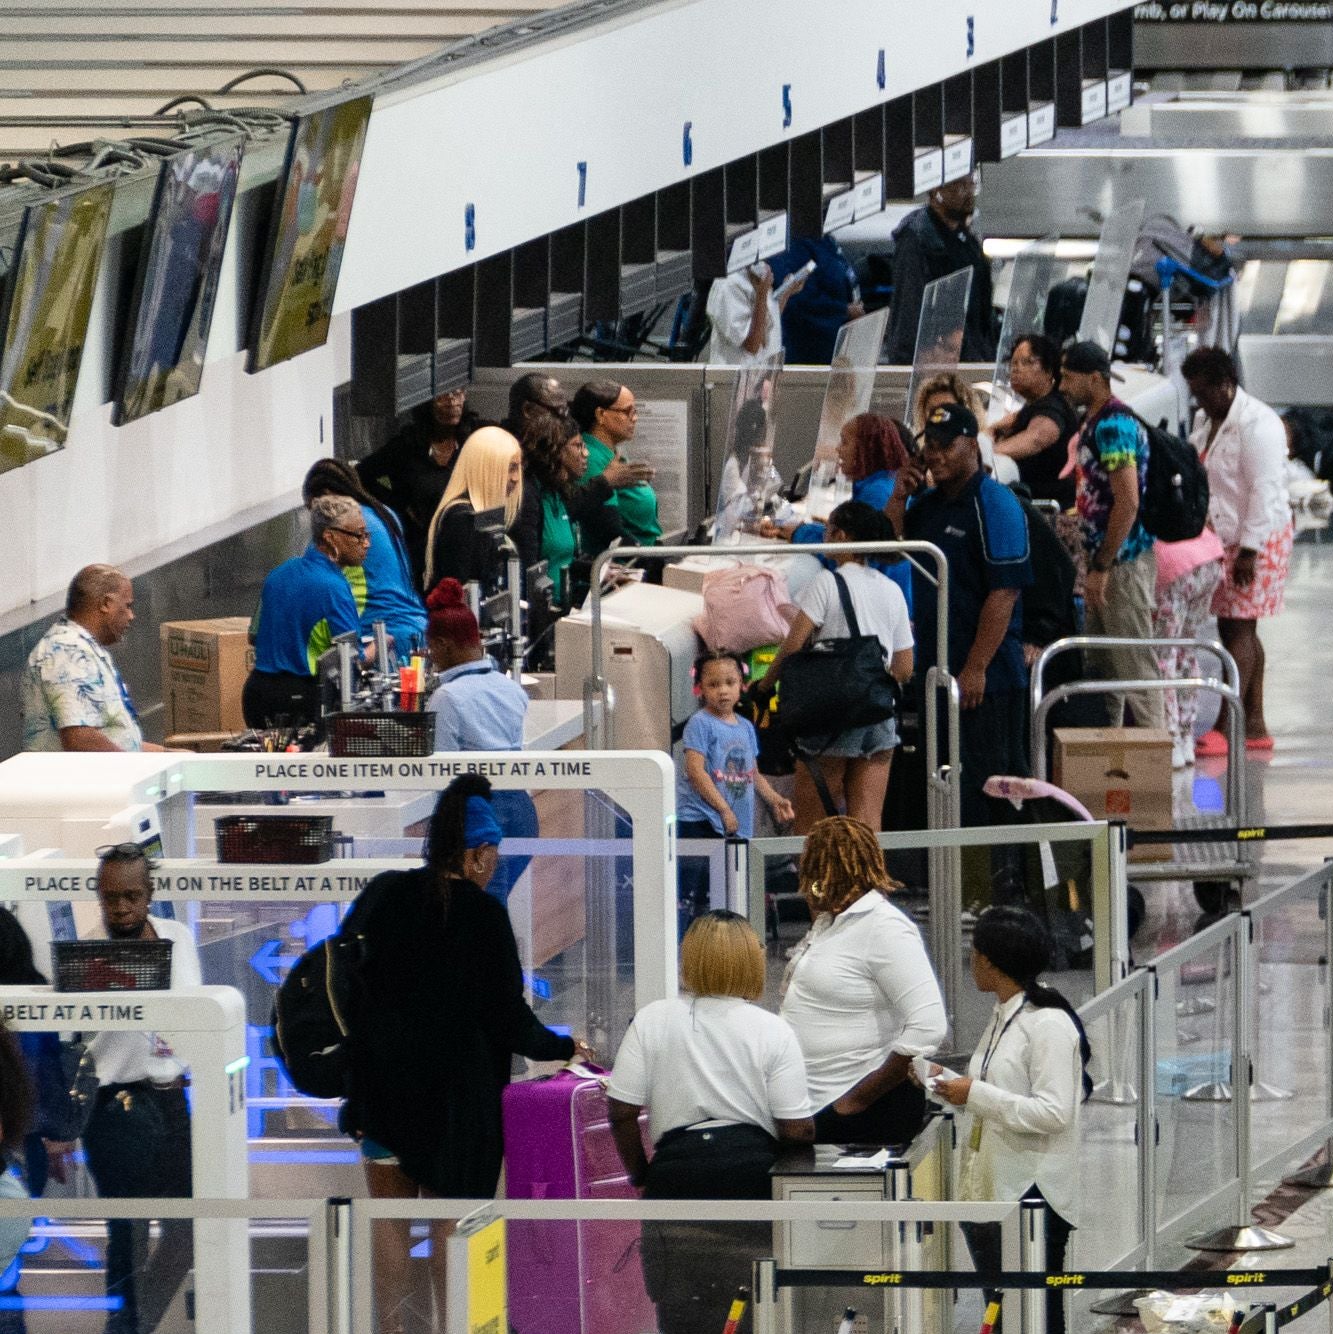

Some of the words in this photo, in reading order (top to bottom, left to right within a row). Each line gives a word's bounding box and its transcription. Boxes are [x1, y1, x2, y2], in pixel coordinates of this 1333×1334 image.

[1192, 2, 1228, 22] Play
[255, 763, 307, 778] PLACE
[313, 763, 348, 778] ONE
[353, 763, 394, 778] ITEM
[399, 763, 423, 777] ON
[428, 762, 463, 777] THE
[467, 762, 506, 776] BELT
[510, 762, 530, 776] AT
[535, 762, 546, 776] A
[549, 762, 591, 776] TIME
[25, 876, 80, 891] PLACE
[176, 877, 201, 891] ON
[208, 877, 243, 891] THE
[249, 877, 288, 891] BELT
[294, 877, 315, 891] AT
[321, 876, 332, 891] A
[336, 876, 371, 891] TIM
[4, 1005, 48, 1020] BELT
[53, 1005, 76, 1020] AT
[80, 1005, 93, 1020] A
[97, 1005, 144, 1020] TIME
[863, 1273, 903, 1286] spirit
[1046, 1274, 1086, 1287] spirit
[1226, 1273, 1266, 1285] spirit
